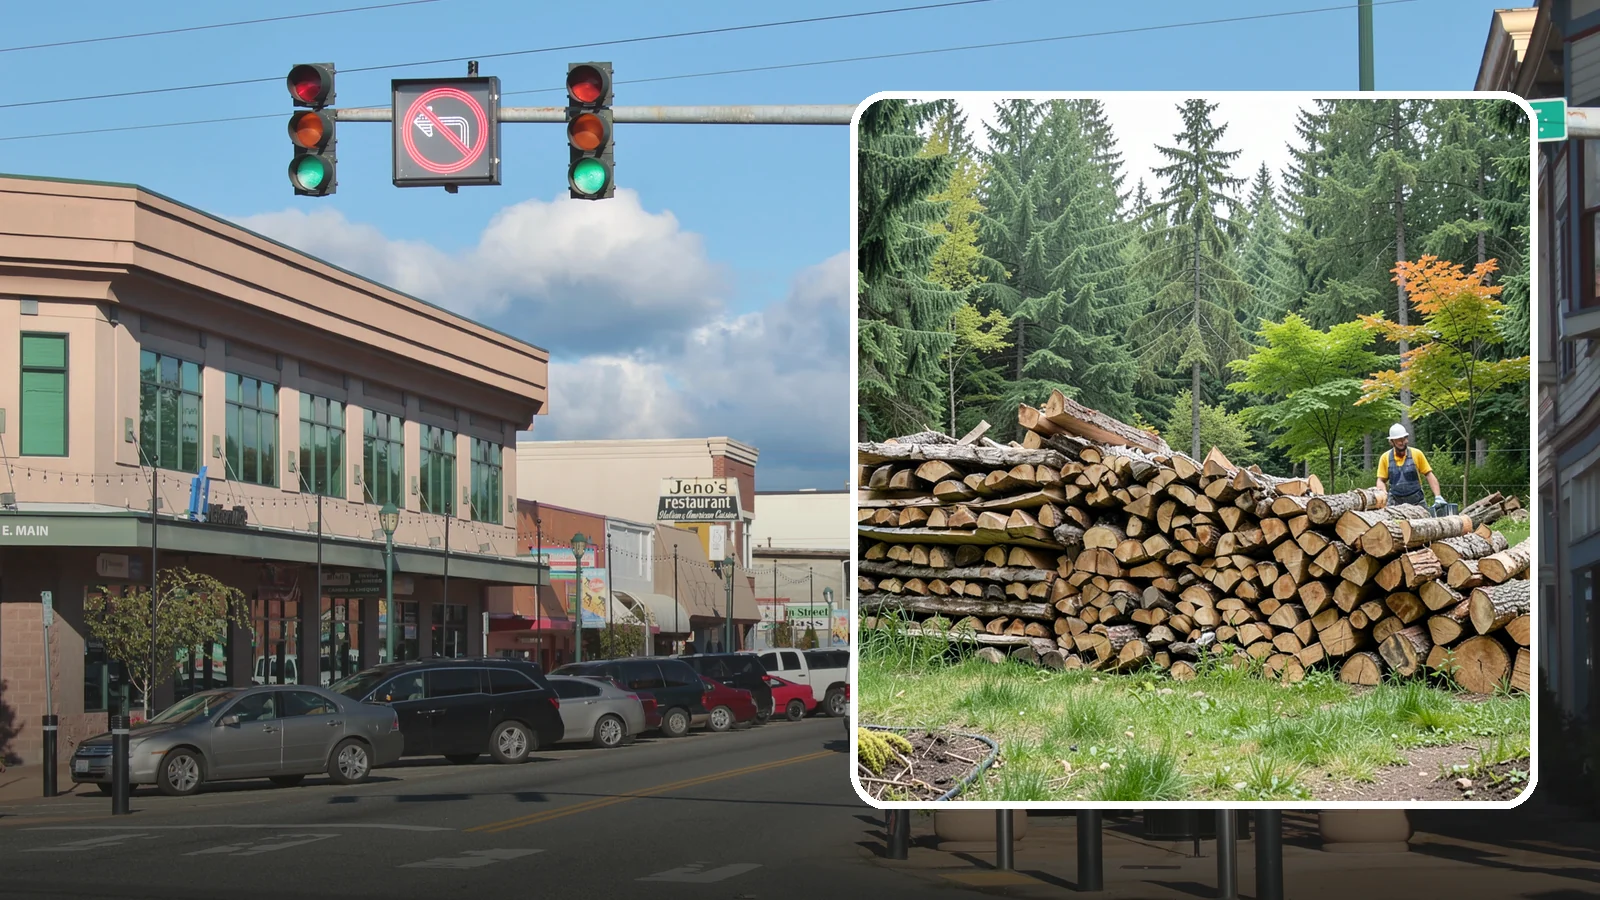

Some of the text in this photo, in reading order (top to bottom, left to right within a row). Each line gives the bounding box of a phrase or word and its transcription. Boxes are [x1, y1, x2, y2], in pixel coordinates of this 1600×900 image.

[670, 480, 727, 494] Jeno's
[665, 496, 731, 509] restaurant
[658, 510, 681, 520] Italian
[686, 510, 714, 519] American
[715, 510, 737, 519] Cuisine
[2, 525, 49, 536] E. MAIN
[797, 607, 828, 617] Street
[790, 619, 823, 627] lass
